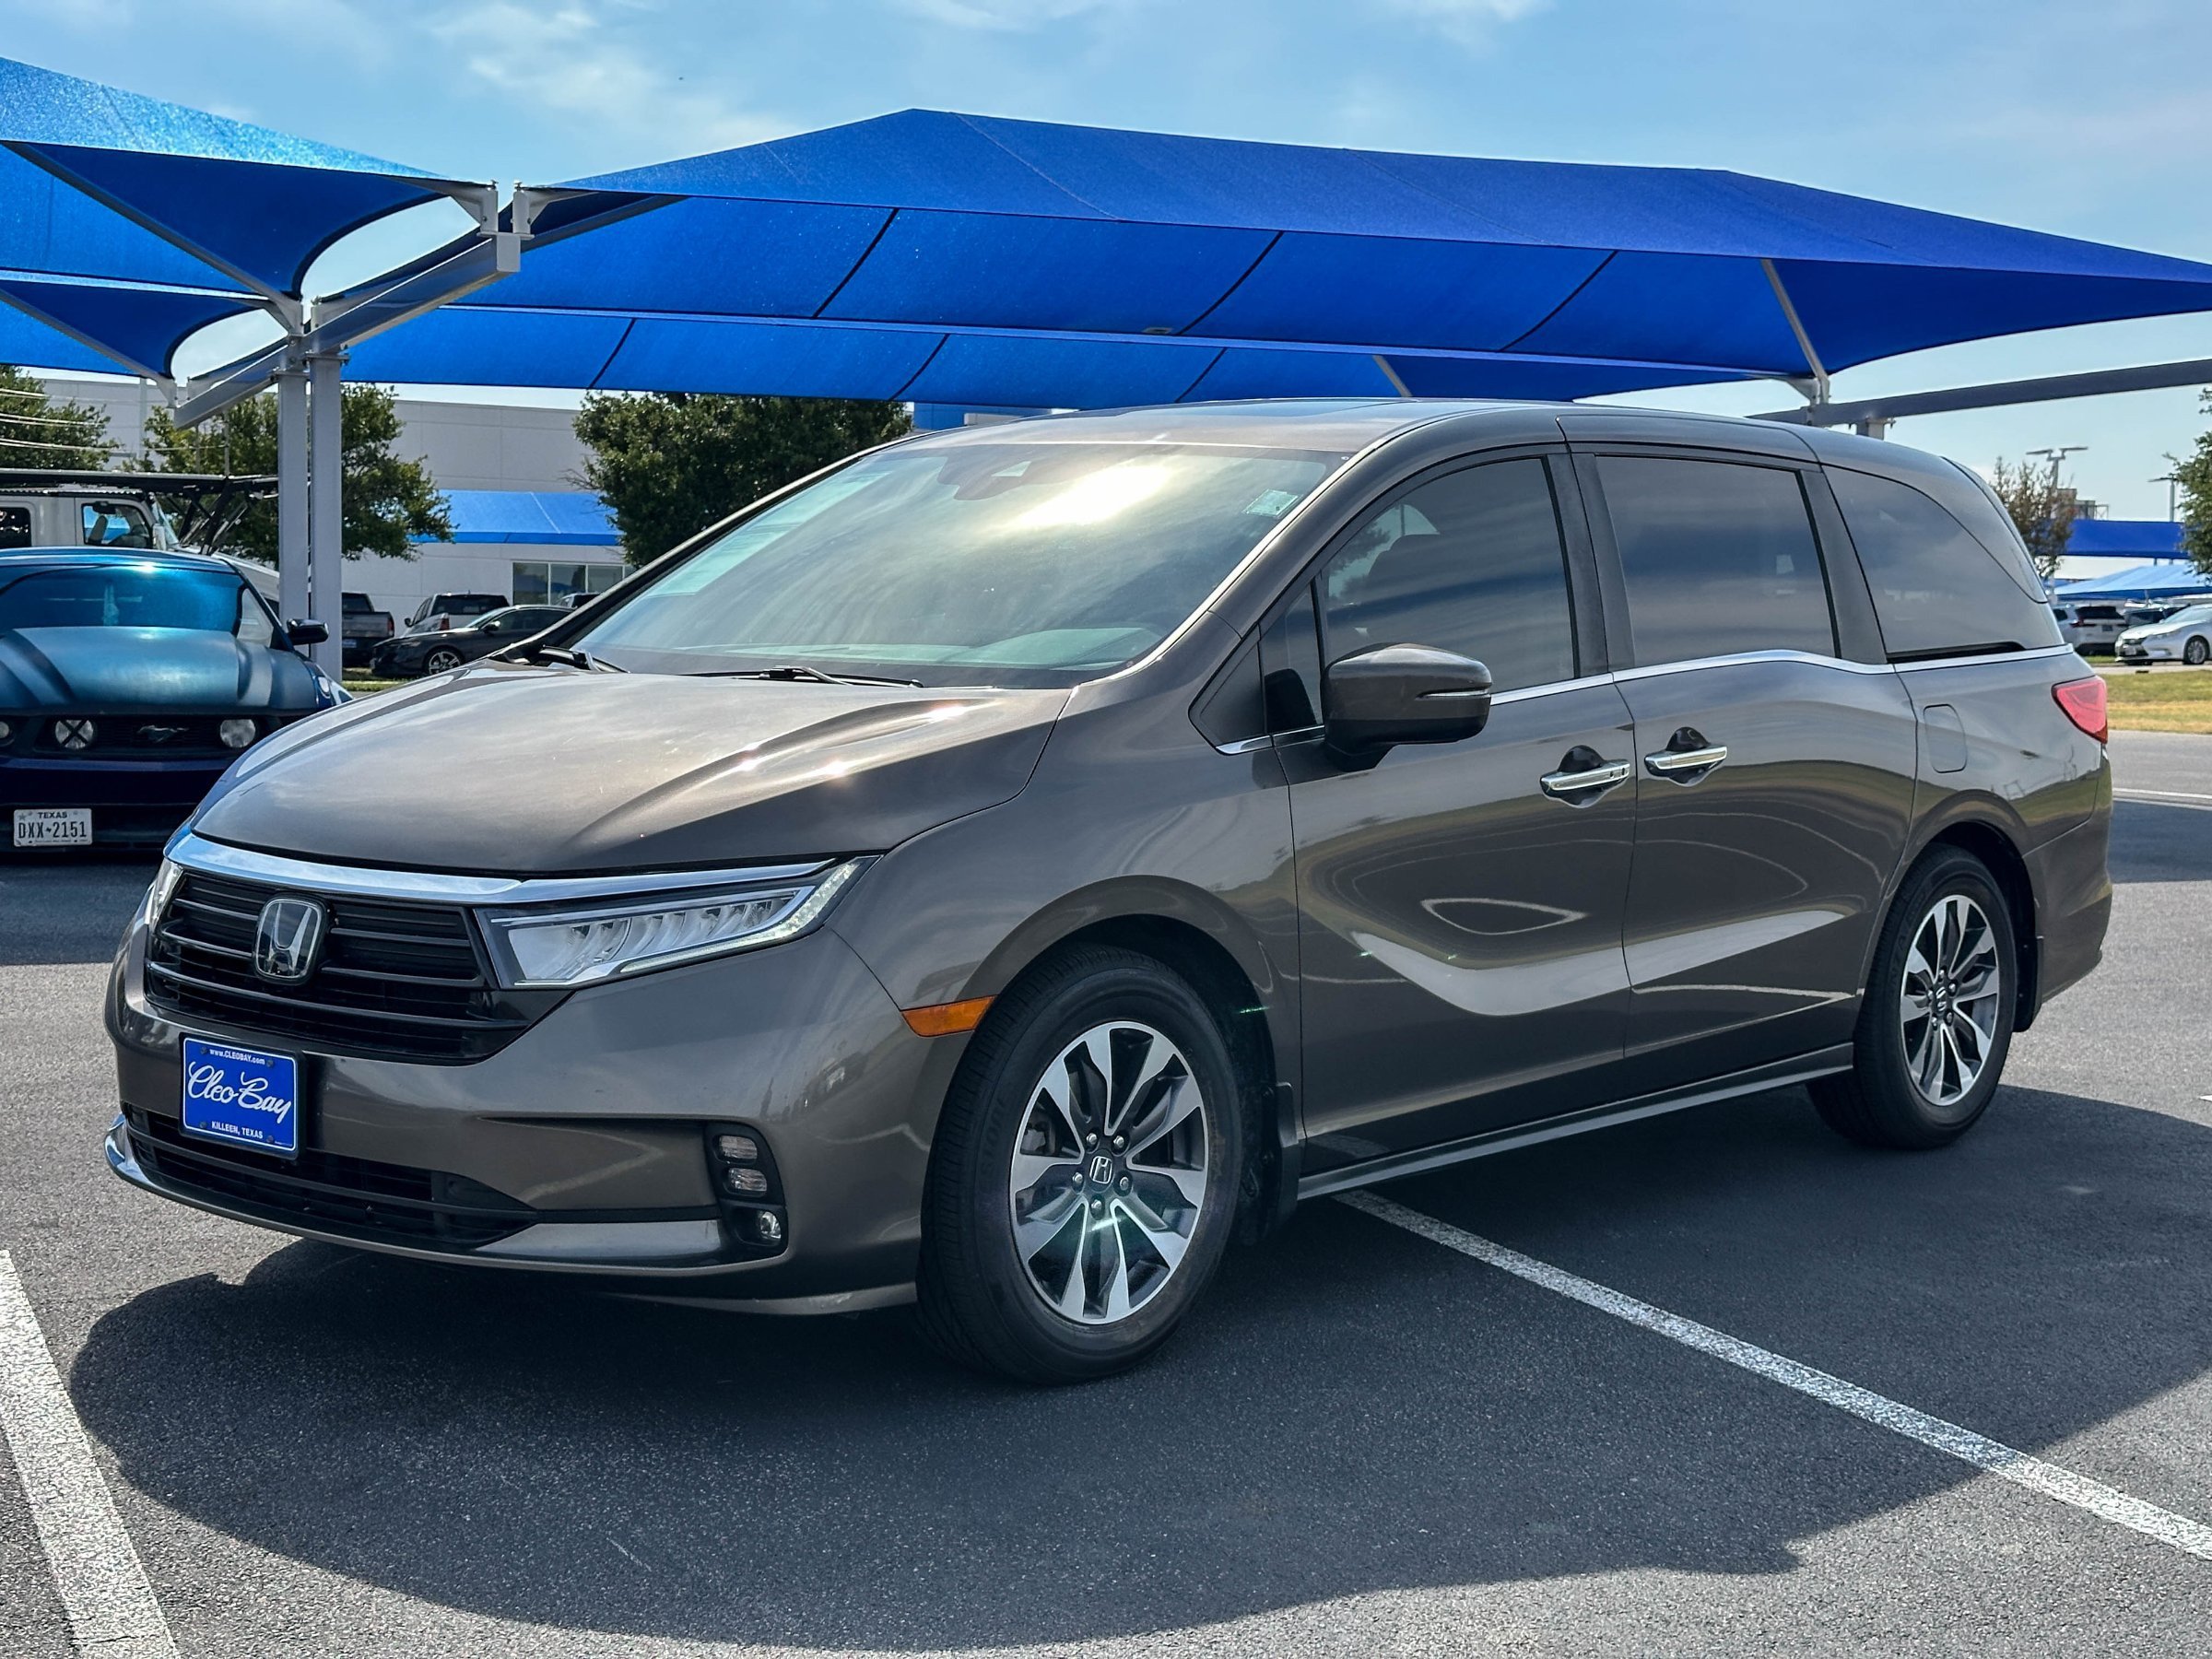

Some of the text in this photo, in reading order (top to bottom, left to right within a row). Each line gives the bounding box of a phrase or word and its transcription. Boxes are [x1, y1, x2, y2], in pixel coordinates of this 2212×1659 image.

[37, 811, 68, 819] TEXAS
[209, 1048, 265, 1065] www.CLEOBAY.com
[188, 1061, 292, 1124] Cleo Bay
[211, 1121, 264, 1140] KILLEEN, TEXAS
